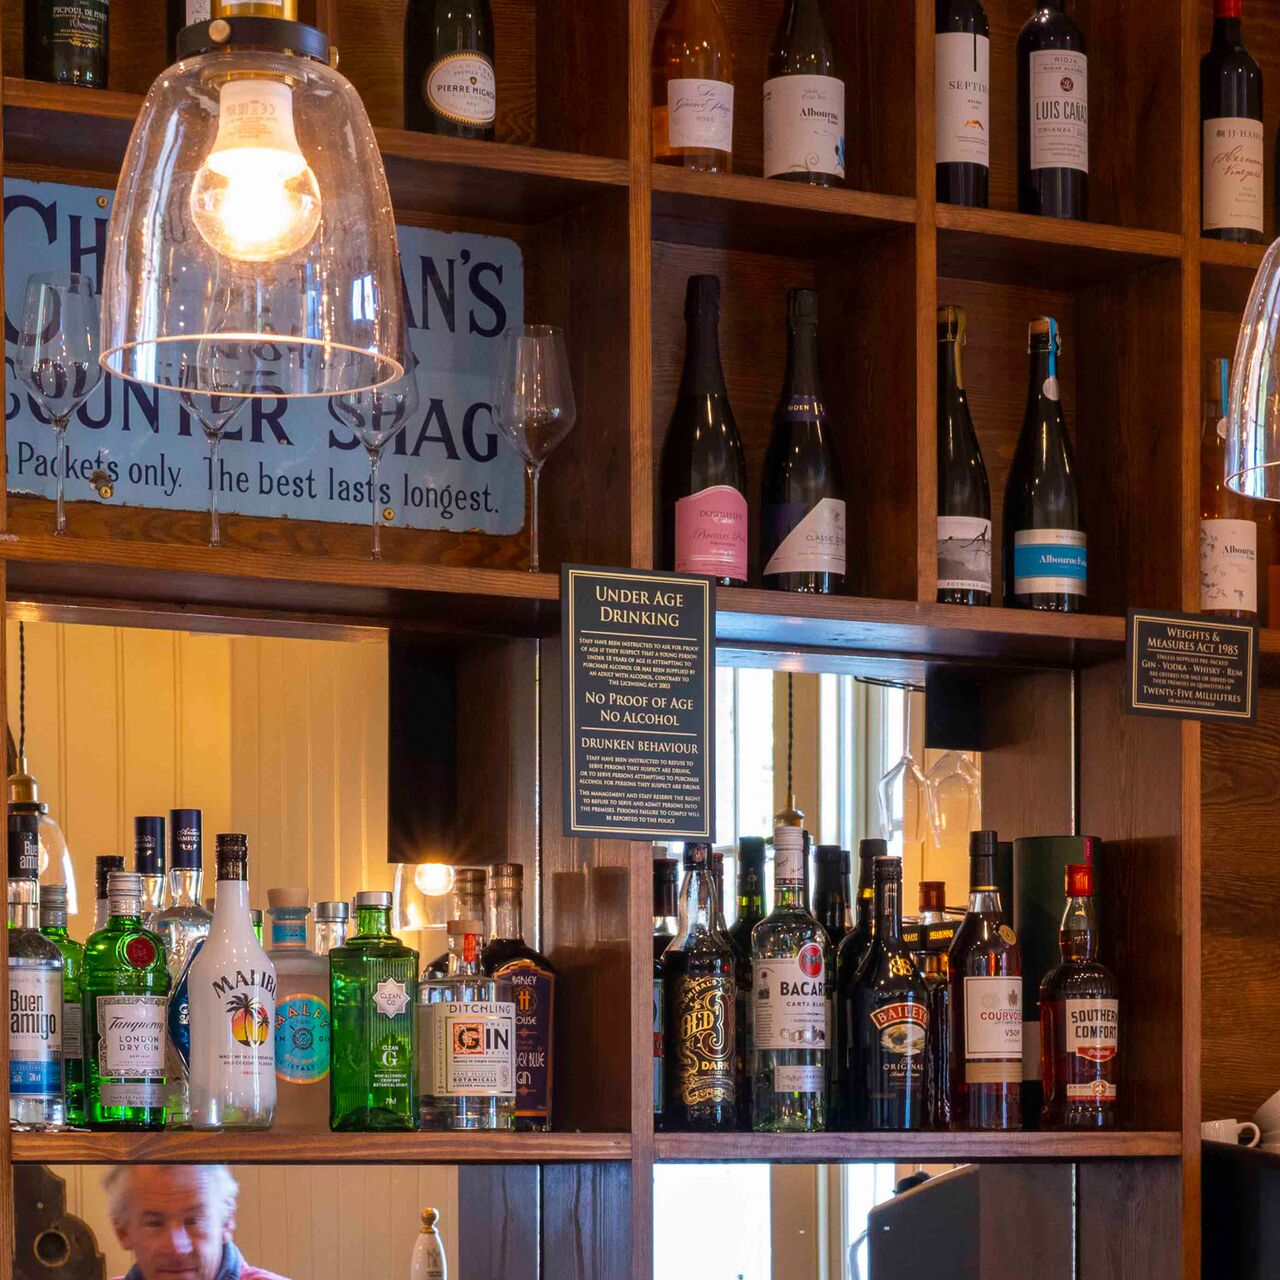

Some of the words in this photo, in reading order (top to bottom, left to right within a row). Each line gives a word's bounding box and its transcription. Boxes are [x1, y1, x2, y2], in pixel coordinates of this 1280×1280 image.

[437, 84, 471, 94] PIERRE
[1036, 101, 1060, 121] LUIS
[329, 395, 499, 464] SHAG
[17, 441, 120, 483] Packets
[128, 453, 182, 498] only.
[204, 456, 250, 496] The
[259, 461, 317, 499] best
[328, 467, 391, 504] lasts
[403, 473, 500, 520] longest.
[595, 586, 650, 605] UNDER
[653, 591, 683, 608] AGE
[599, 606, 680, 627] DRINKING
[1167, 627, 1210, 641] WEIGHTS
[1211, 632, 1221, 642] &
[622, 640, 653, 648] INSTRUCTED
[1147, 637, 1195, 652] MEASURES
[1196, 643, 1215, 653] ACT
[1218, 644, 1239, 655] 1985
[1141, 659, 1156, 668] GIN
[1162, 661, 1187, 672] VODKA
[1193, 665, 1220, 675] WHISKY
[1227, 668, 1243, 677] RUM
[585, 691, 606, 705] NO
[609, 693, 649, 708] PROOF
[651, 696, 667, 709] OF
[670, 698, 694, 710] AGE
[1142, 685, 1193, 699] TWENTY-FIVE
[1195, 690, 1241, 703] MILLILITRES
[600, 709, 620, 722] NO
[623, 711, 680, 726] ALCOHOL
[581, 737, 635, 751] DRUNKEN
[638, 740, 699, 754] BEHAVIOUR
[10, 989, 44, 1012] Buen
[381, 992, 402, 1000] CLEAN
[108, 1015, 165, 1034] Tanqueray
[515, 1016, 537, 1026] OUSE
[878, 1005, 929, 1028] BAILEYS
[10, 1011, 56, 1041] amigo
[119, 1035, 160, 1043] LONDON
[119, 1043, 140, 1051] DRY
[143, 1043, 160, 1051] GIN
[457, 1026, 509, 1051] GIN
[382, 1051, 397, 1067] G
[701, 1061, 730, 1070] DARK
[882, 1063, 924, 1071] ORIGINAL
[517, 1071, 532, 1086] GIN
